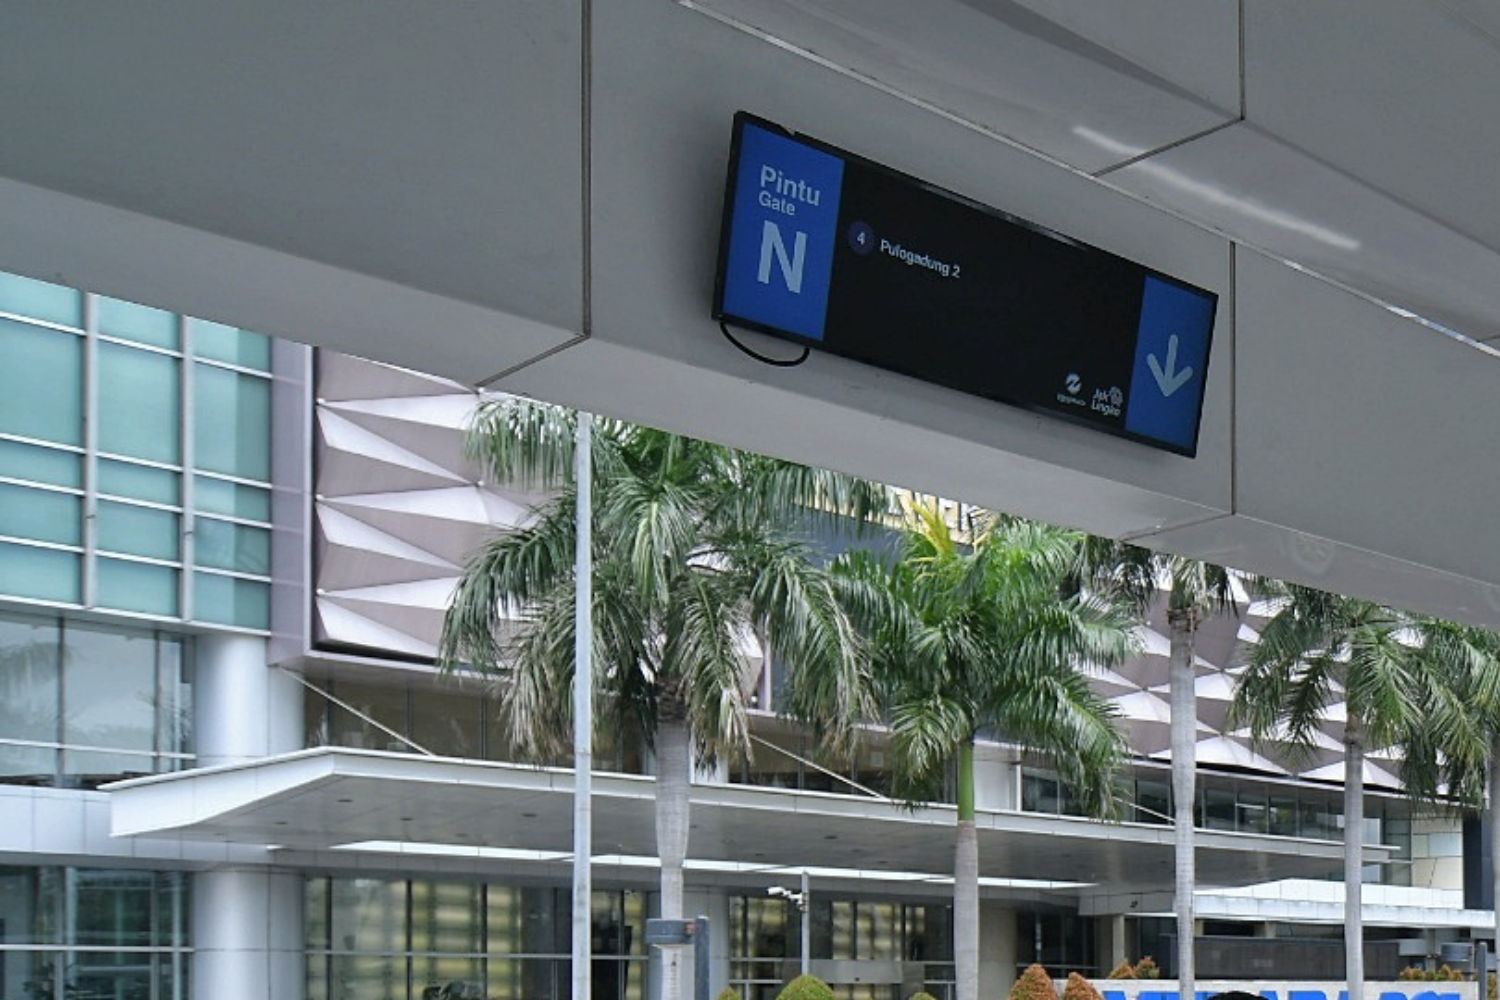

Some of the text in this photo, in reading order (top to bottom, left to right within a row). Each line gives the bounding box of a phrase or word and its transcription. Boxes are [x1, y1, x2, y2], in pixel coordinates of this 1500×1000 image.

[758, 190, 796, 216] Gate
[760, 164, 821, 206] Pintu
[757, 220, 807, 294] N
[857, 232, 866, 245] 4
[952, 264, 960, 278] 2
